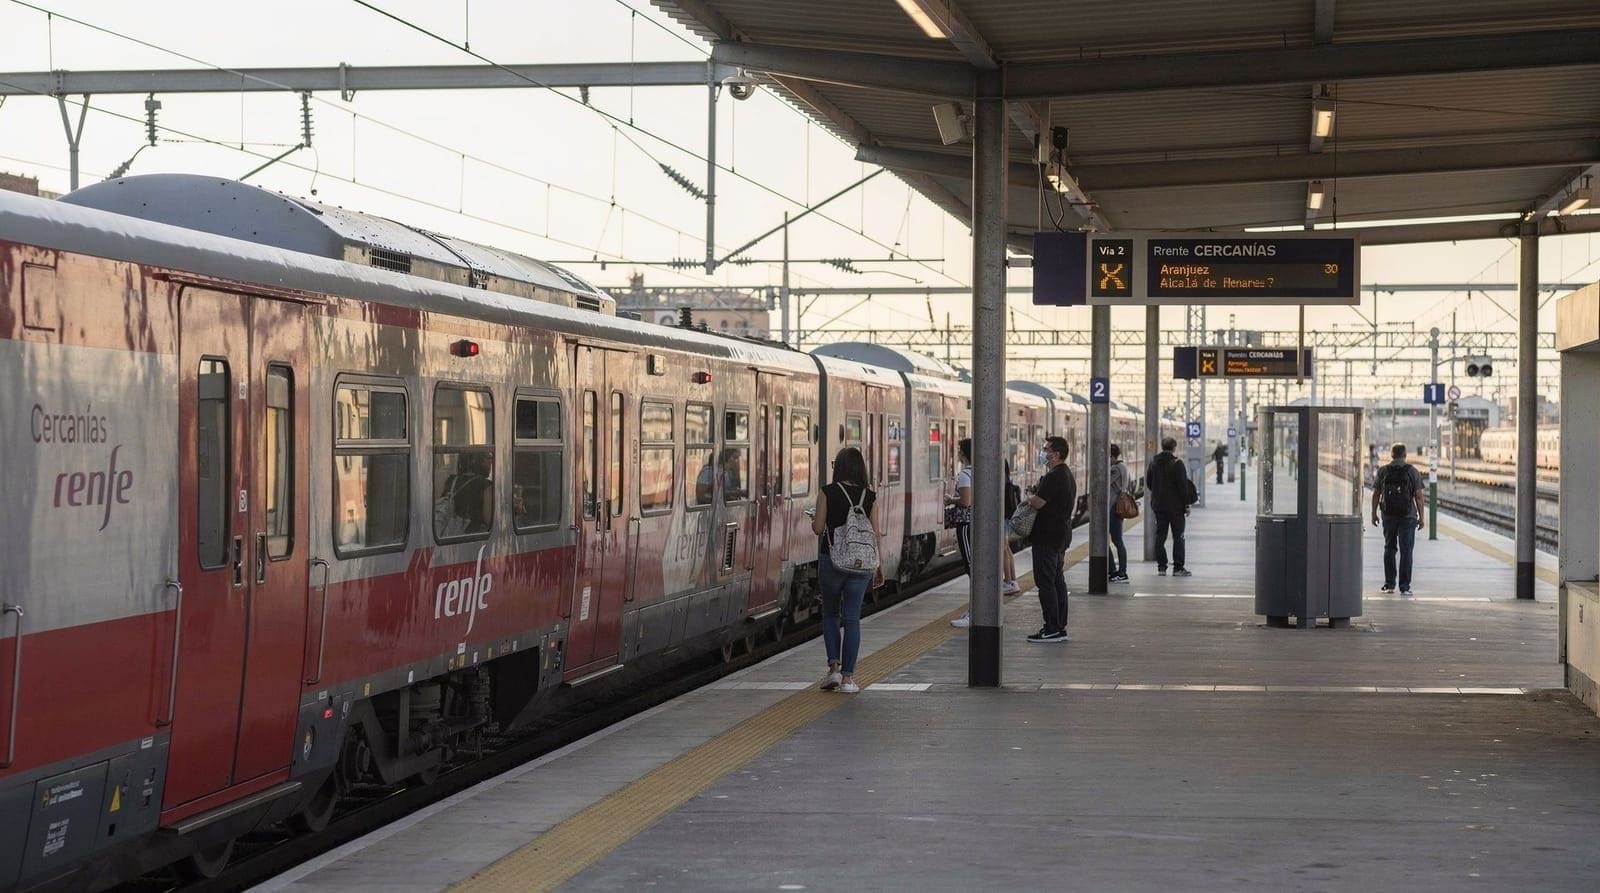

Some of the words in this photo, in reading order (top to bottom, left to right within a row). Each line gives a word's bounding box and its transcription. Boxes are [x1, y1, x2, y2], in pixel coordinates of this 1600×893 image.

[1118, 246, 1125, 255] 2
[1194, 242, 1277, 257] CERCANÍAS
[1160, 264, 1210, 277] Aranjuez
[1325, 264, 1338, 274] 30
[1160, 277, 1198, 289] Alcalá
[1203, 278, 1217, 288] de
[1094, 382, 1105, 397] 2
[1430, 385, 1437, 401] 1
[31, 402, 107, 444] Cercanías
[53, 444, 133, 531] renfe
[434, 544, 492, 638] renfe
